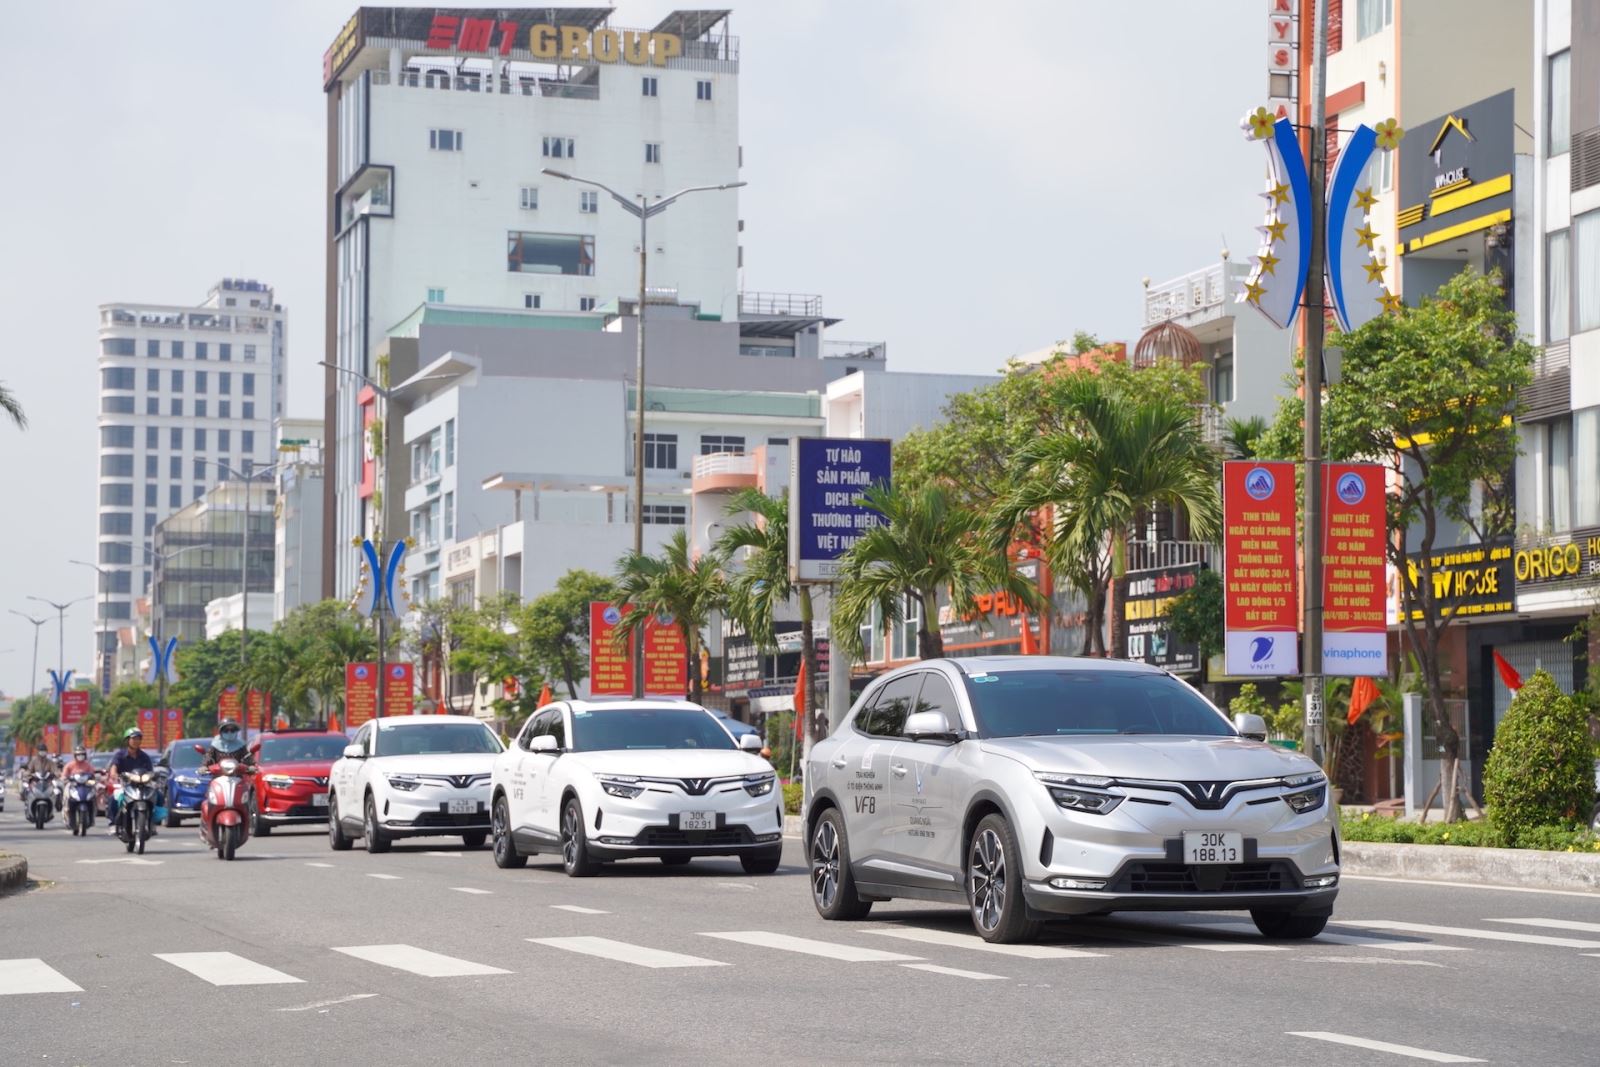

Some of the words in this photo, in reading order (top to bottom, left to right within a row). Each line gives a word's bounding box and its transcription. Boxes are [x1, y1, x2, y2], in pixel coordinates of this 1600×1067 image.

[530, 24, 680, 66] GROUP
[826, 448, 840, 466] TỰ
[841, 447, 861, 464] HÀO
[816, 465, 838, 485] SẢN
[825, 491, 849, 509] DỊCH
[812, 512, 852, 528] THƯƠNG
[817, 532, 839, 552] VIỆT
[1514, 542, 1581, 581] ORIGO
[1454, 566, 1499, 597] HOUSE
[1323, 647, 1382, 660] vinaphone
[854, 795, 876, 814] VF8
[1201, 833, 1226, 847] 30K
[1192, 848, 1236, 861] 188.13
